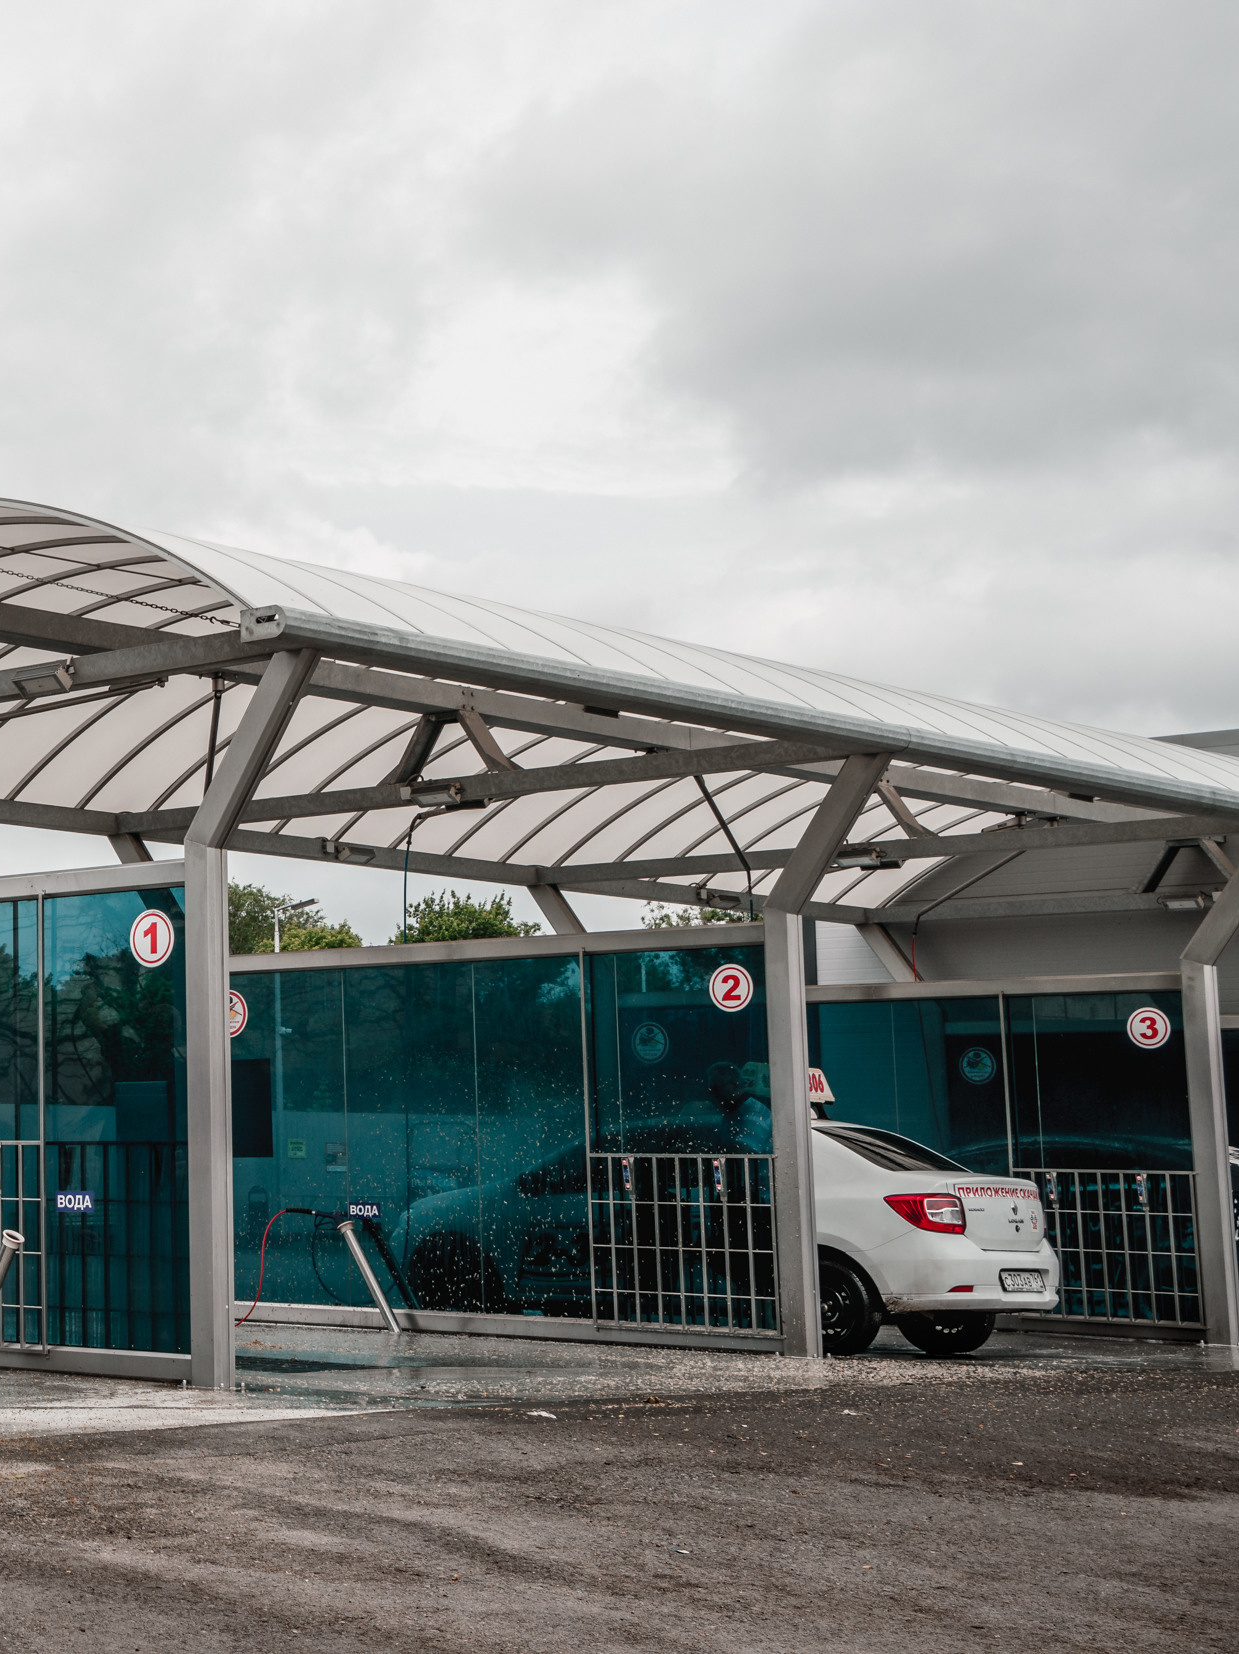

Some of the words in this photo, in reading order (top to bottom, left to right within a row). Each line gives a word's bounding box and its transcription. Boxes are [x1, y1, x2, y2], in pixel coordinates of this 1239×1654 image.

[144, 922, 157, 954] 1
[722, 975, 741, 1001] 2
[1139, 1016, 1158, 1040] 3
[57, 1194, 92, 1210] ВОДА
[957, 1186, 1020, 1199] ПРИЛОЖЕНИЕ
[350, 1205, 379, 1218] ВОДА
